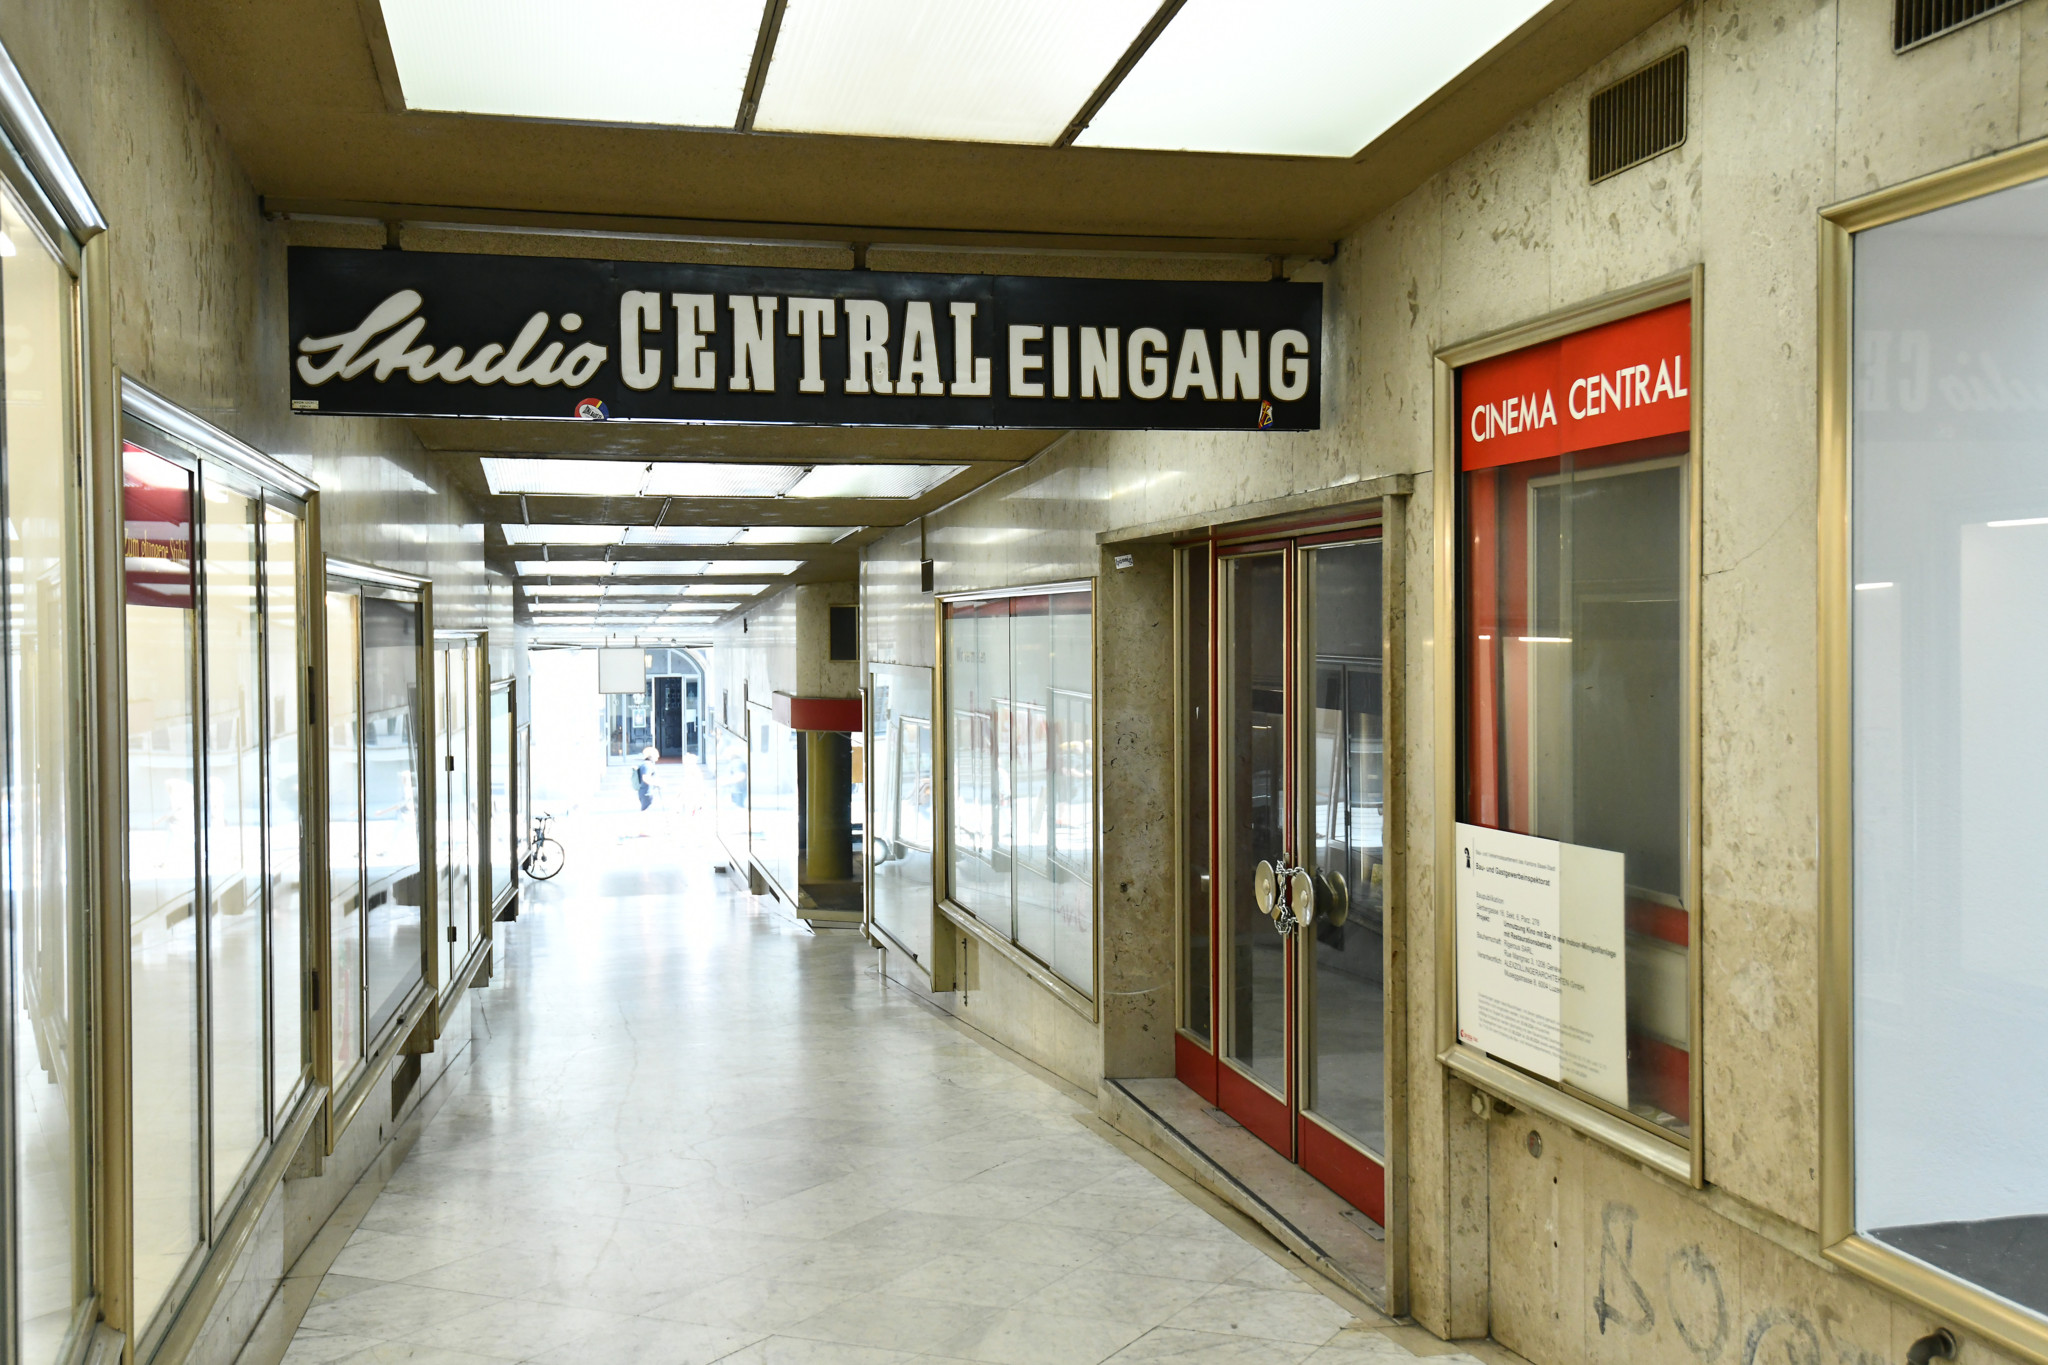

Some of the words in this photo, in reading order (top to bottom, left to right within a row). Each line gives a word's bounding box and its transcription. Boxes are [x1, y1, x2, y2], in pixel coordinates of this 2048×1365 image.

[296, 288, 607, 388] Studio
[620, 290, 992, 396] CENTRAL
[1007, 324, 1310, 401] EINGANG
[1471, 388, 1558, 443] CINEMA
[1568, 354, 1688, 420] CENTRAL
